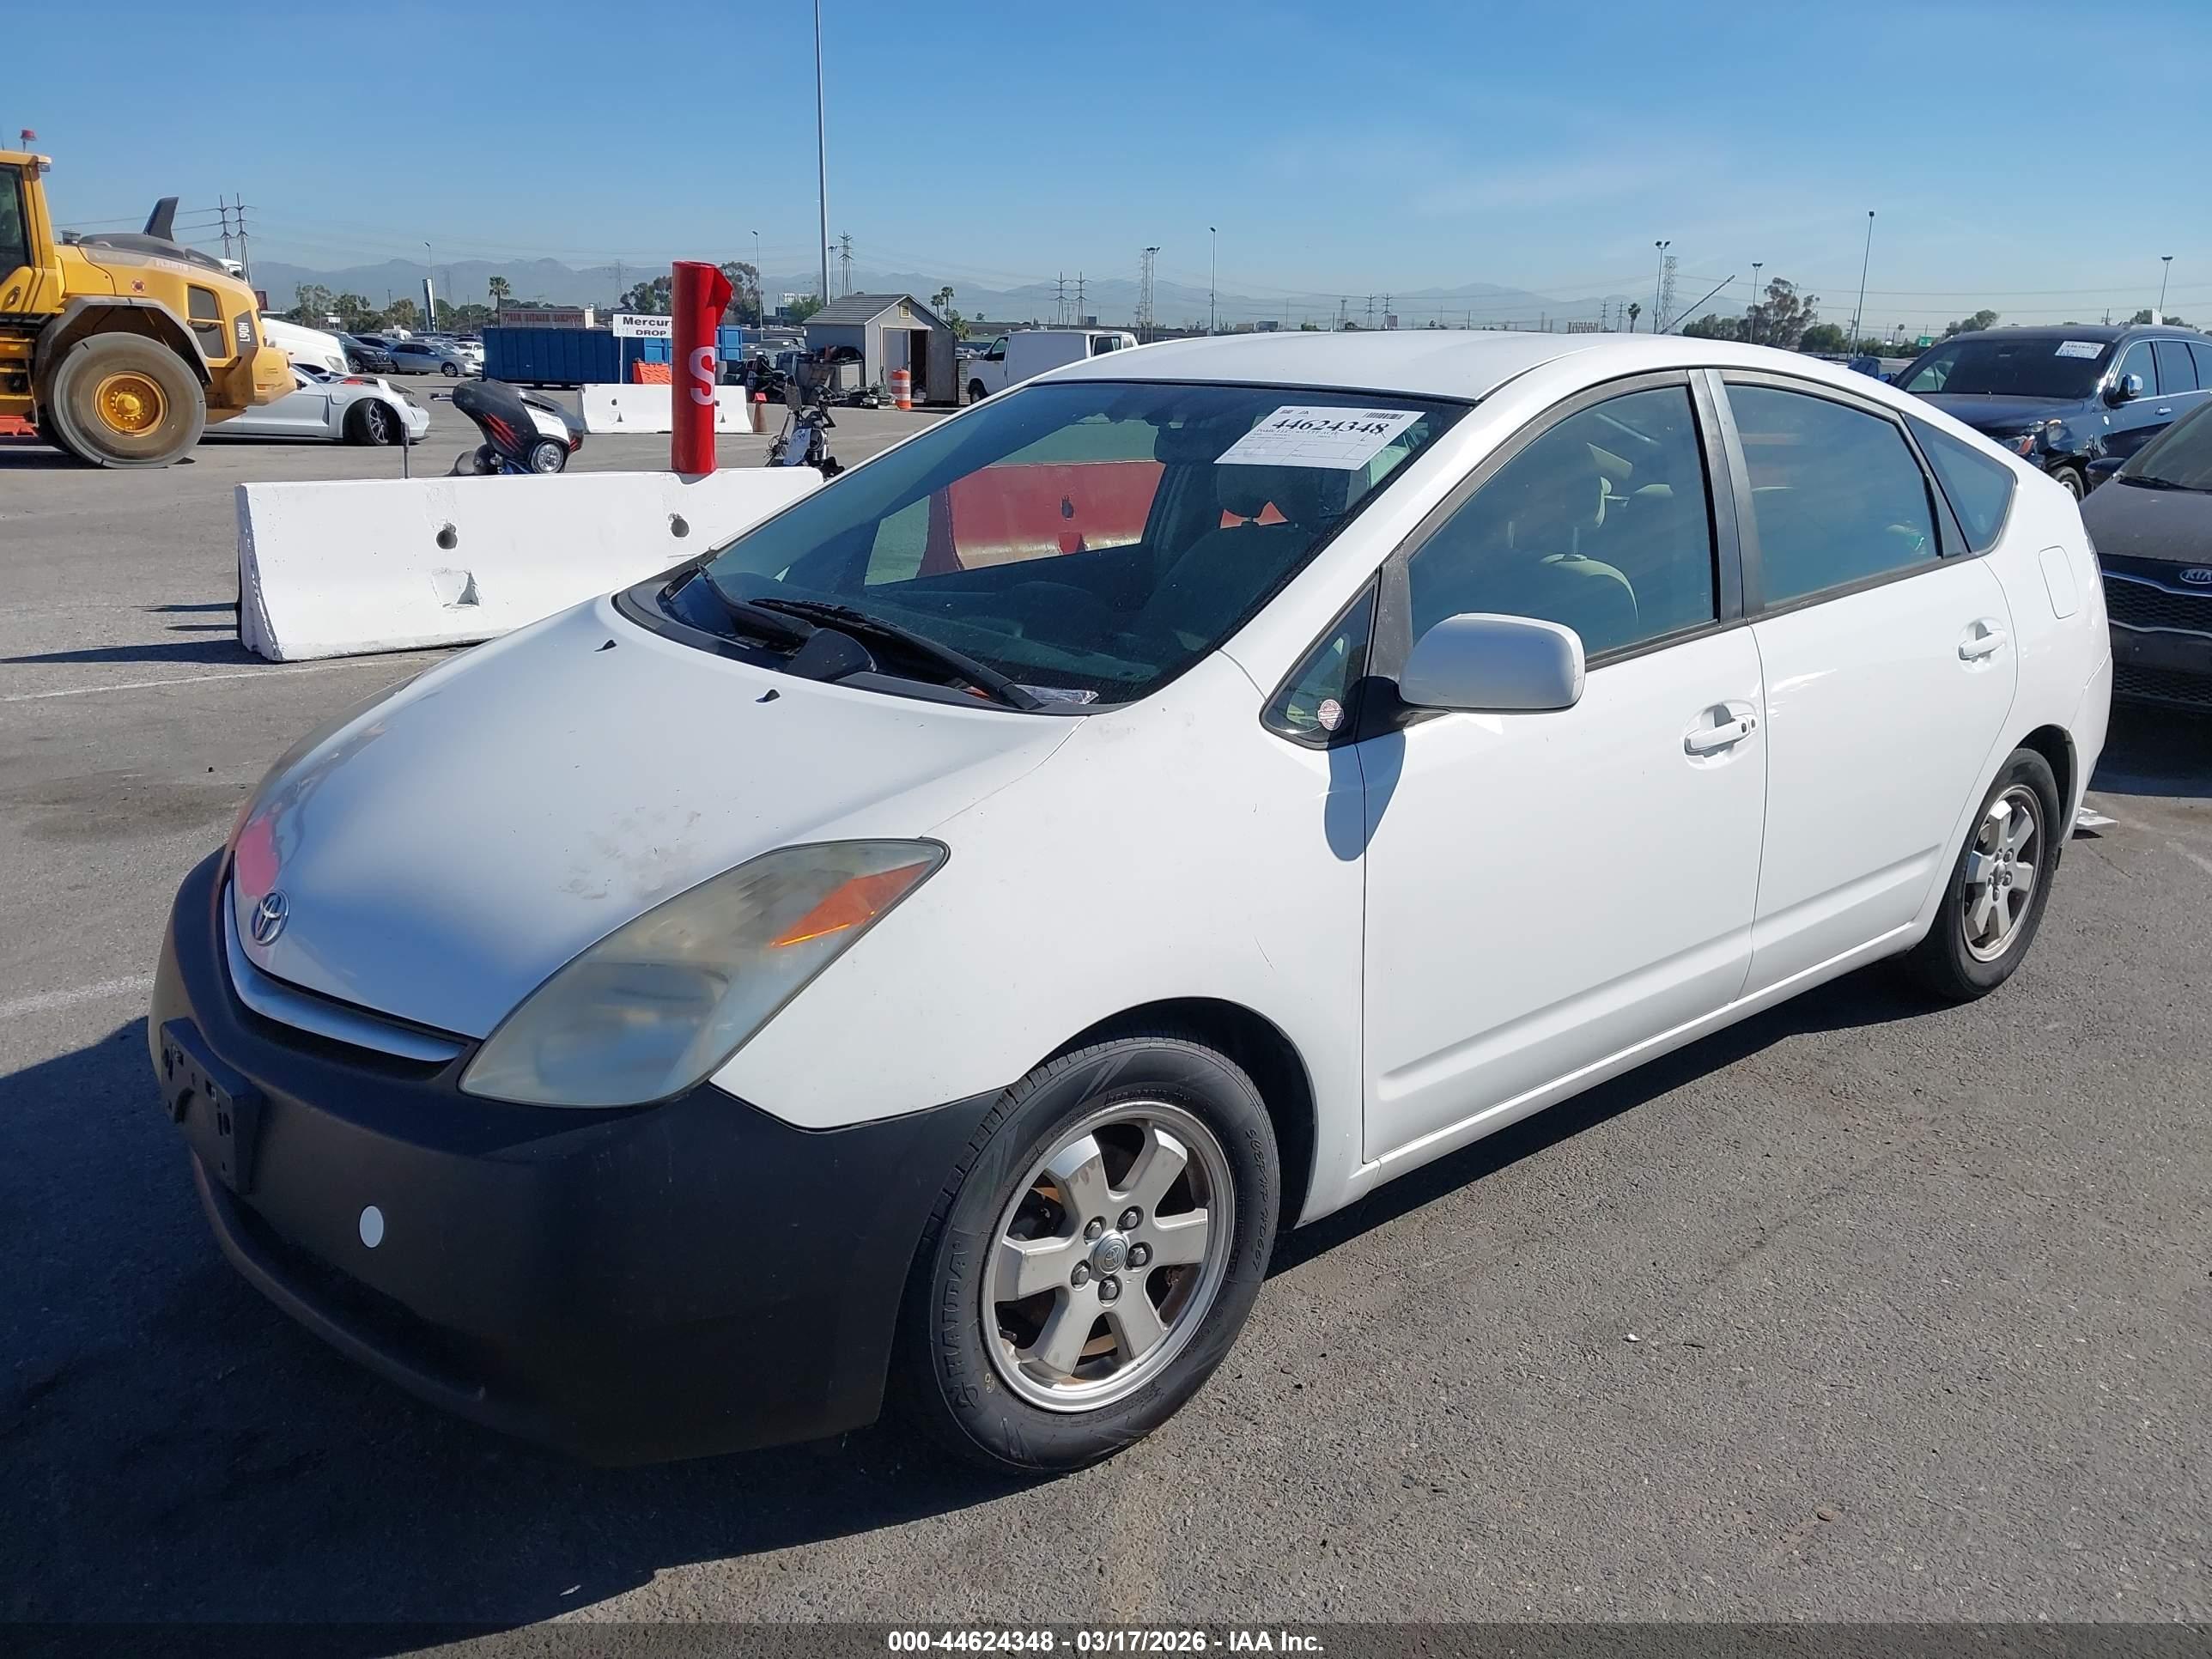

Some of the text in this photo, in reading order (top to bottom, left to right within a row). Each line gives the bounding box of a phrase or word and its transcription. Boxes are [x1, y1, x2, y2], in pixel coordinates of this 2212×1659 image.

[623, 316, 672, 327] Mercur
[238, 322, 251, 342] L90H
[690, 346, 715, 405] S
[1272, 418, 1390, 434] 44624348
[2185, 569, 2212, 580] KIA
